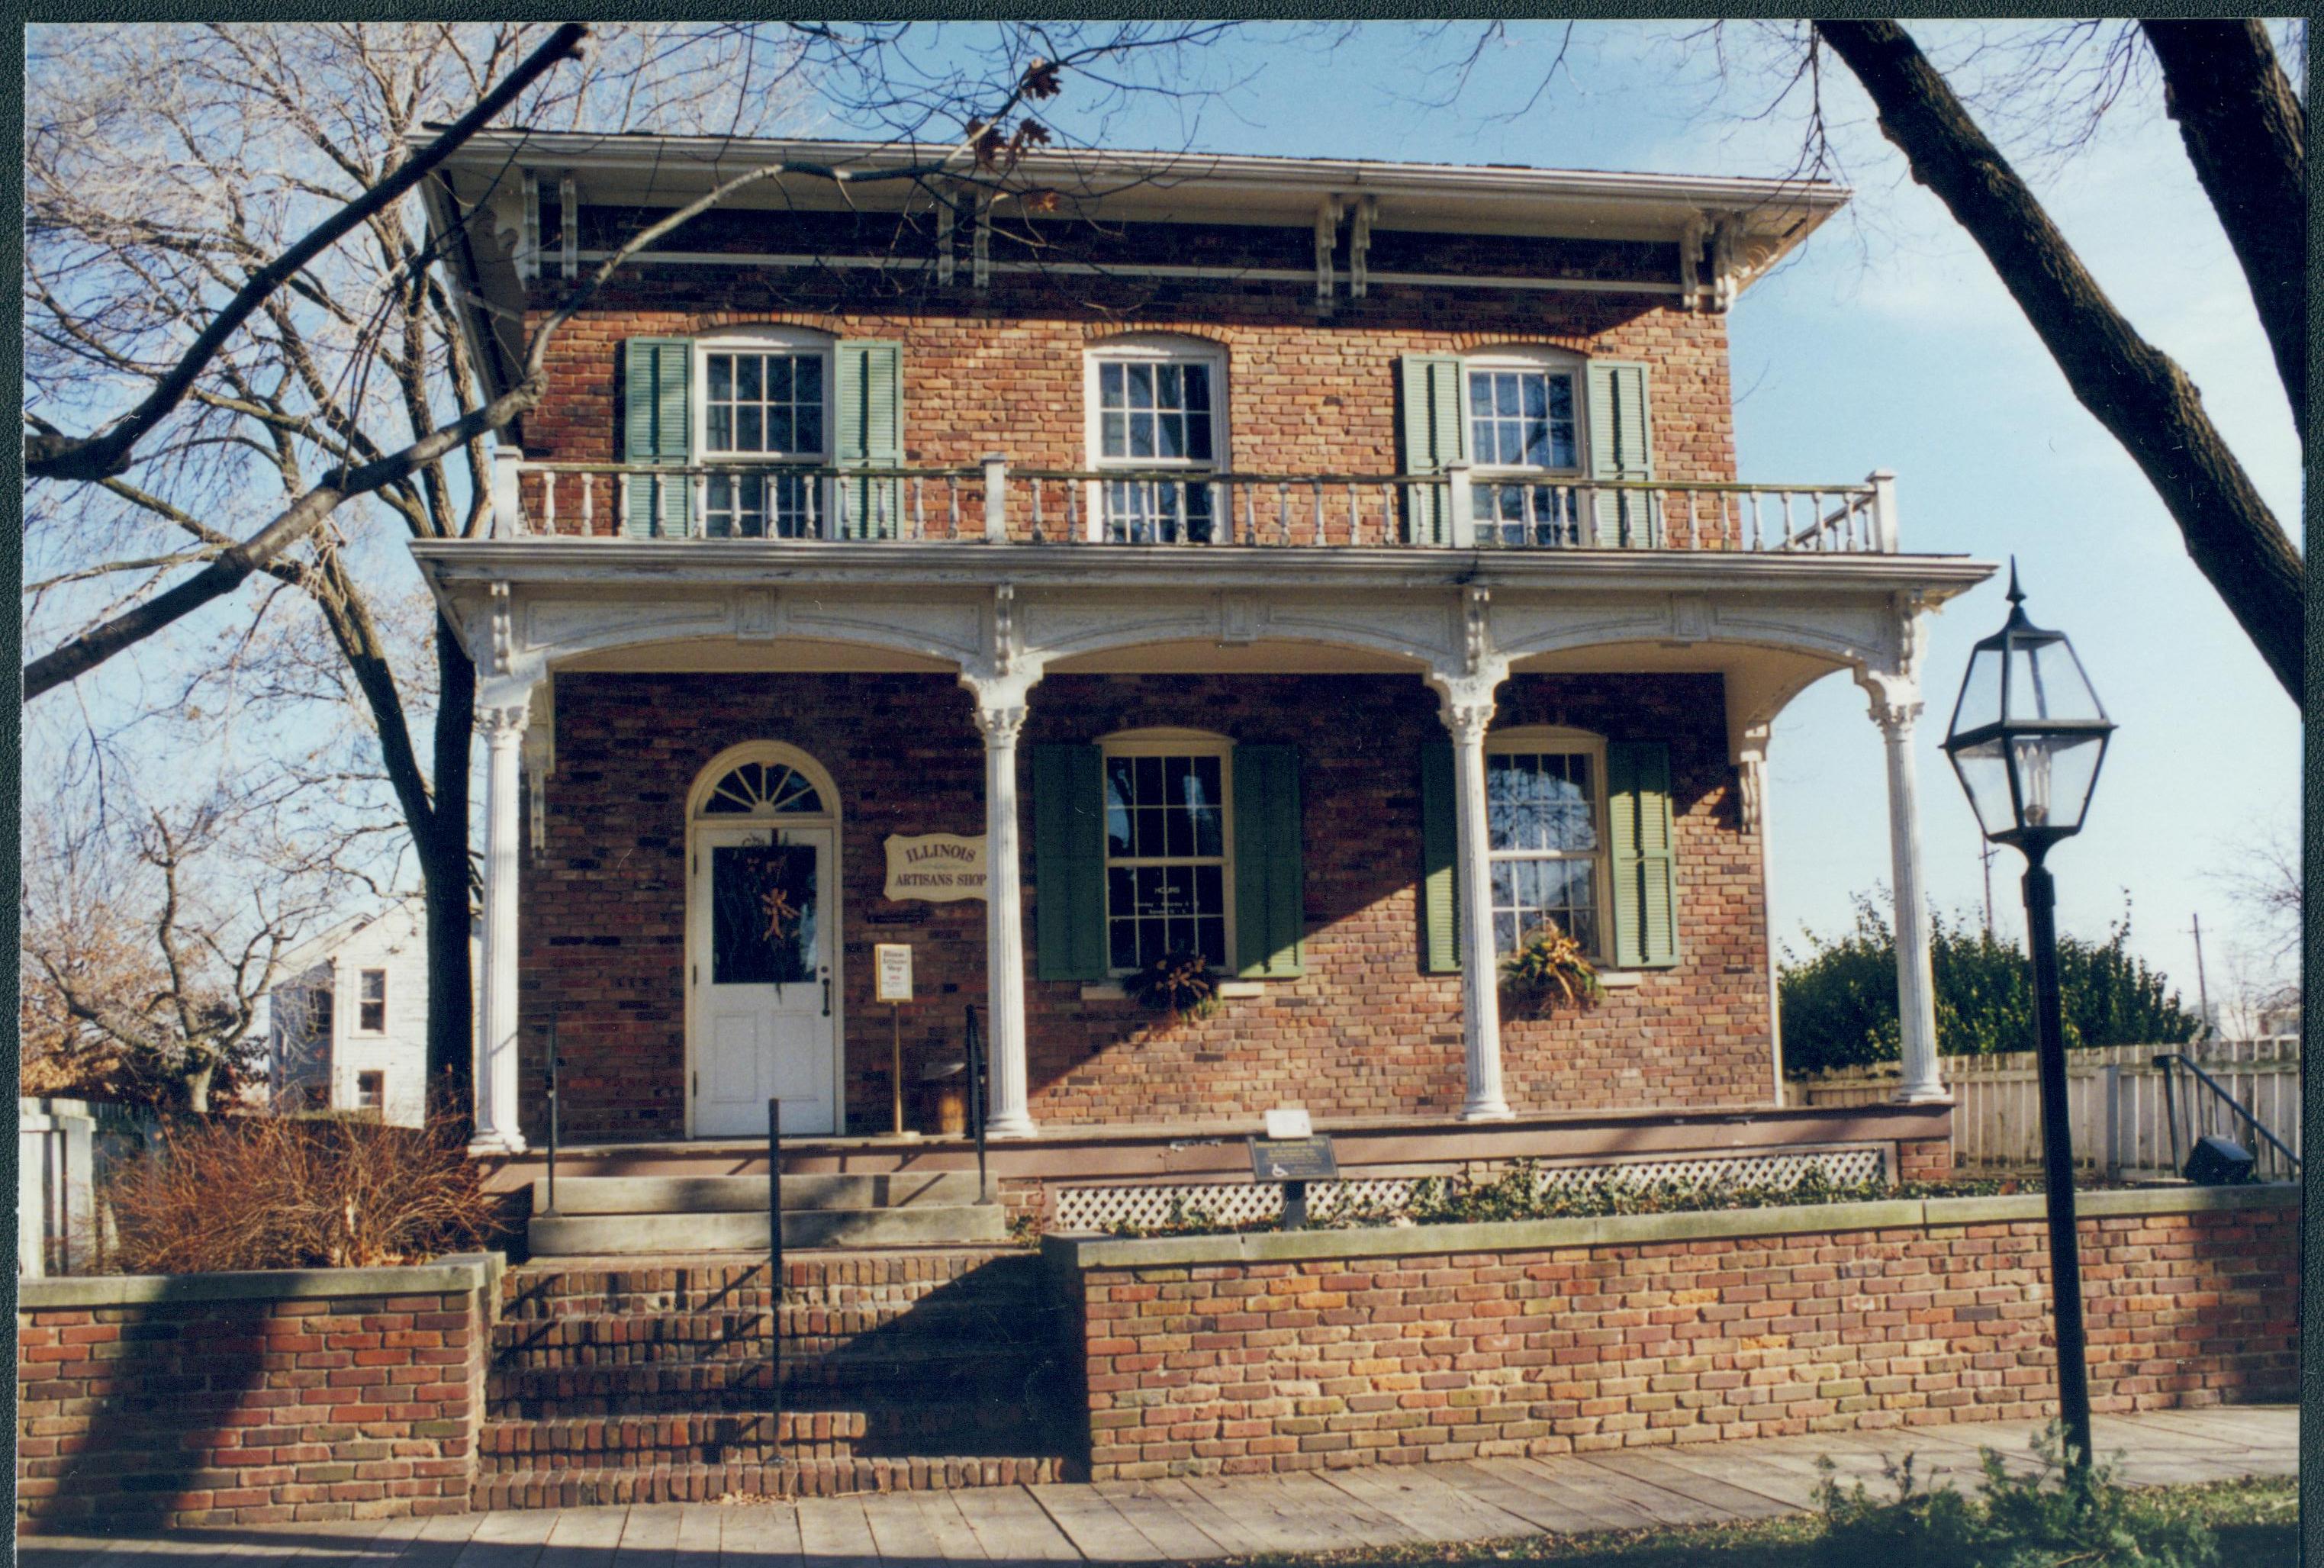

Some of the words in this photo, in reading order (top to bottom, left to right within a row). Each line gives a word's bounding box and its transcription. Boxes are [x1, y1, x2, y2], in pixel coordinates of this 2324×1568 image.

[906, 844, 976, 864] ILLINOIS
[896, 874, 953, 886] ARTISANS
[957, 874, 987, 886] SHOP
